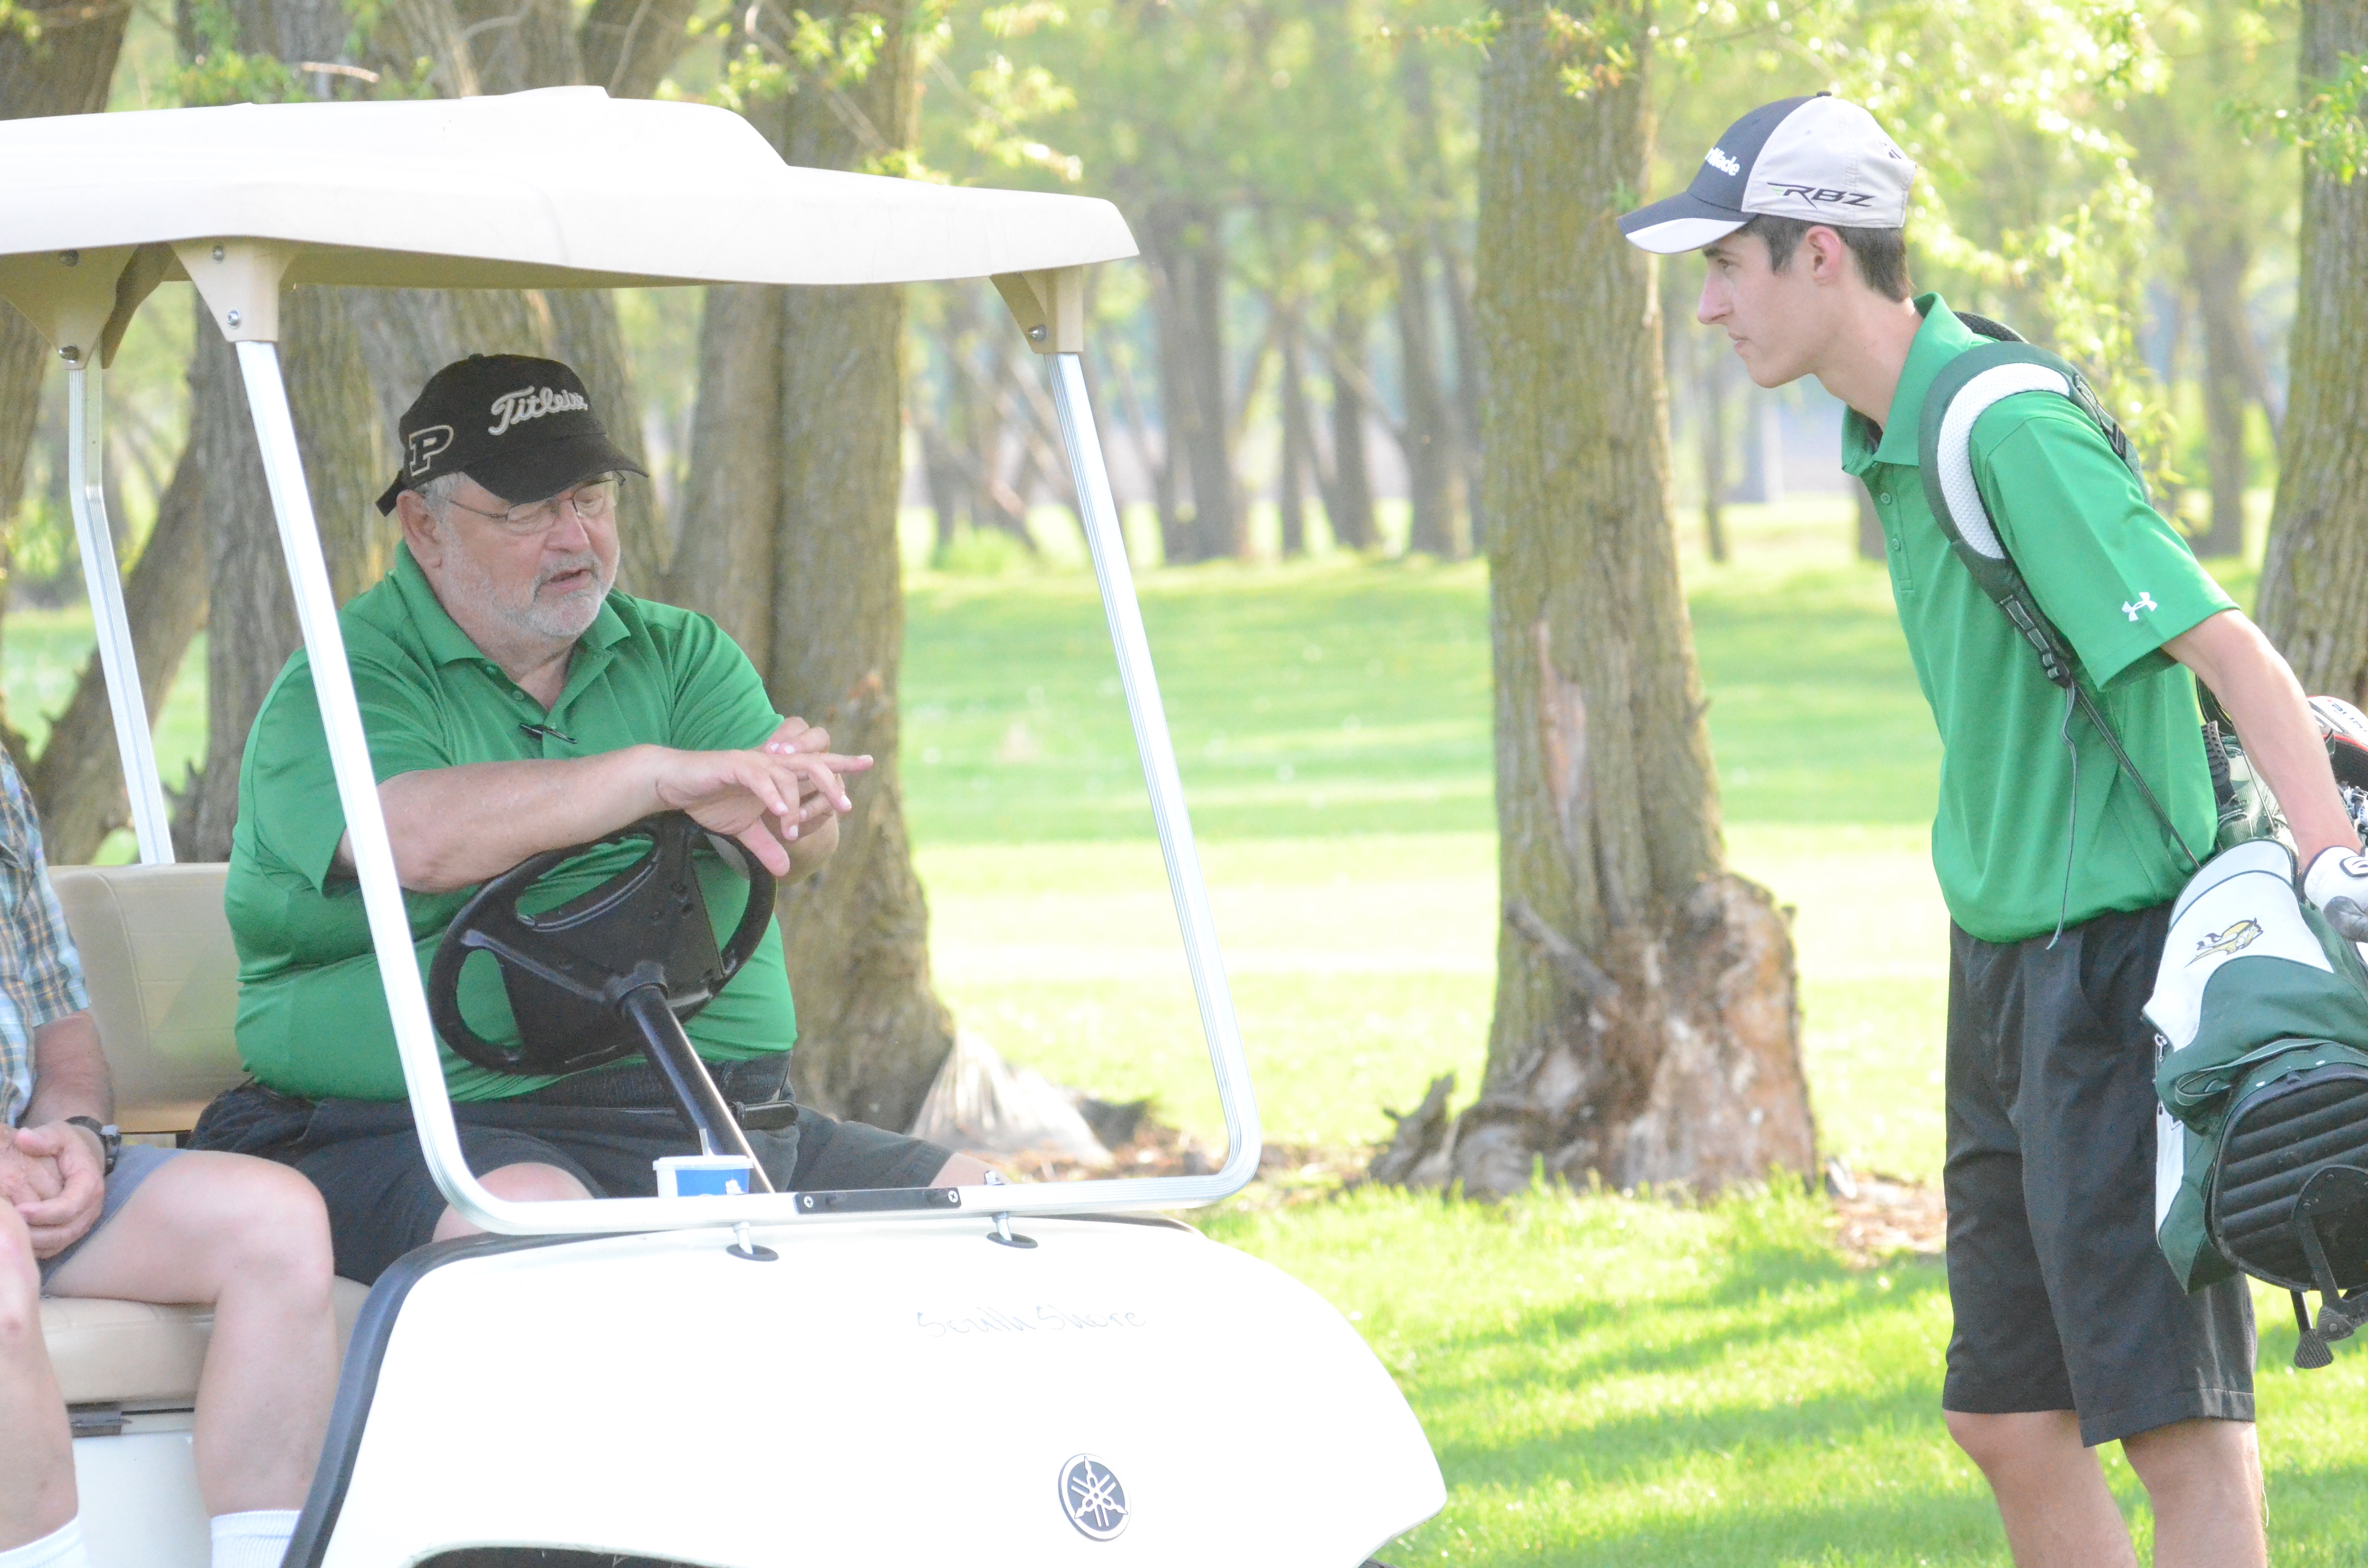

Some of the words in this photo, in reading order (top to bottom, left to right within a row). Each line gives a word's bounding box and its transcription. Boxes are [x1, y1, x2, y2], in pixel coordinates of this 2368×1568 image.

[1767, 182, 1875, 209] RBZ
[409, 425, 453, 477] P
[1036, 1304, 1146, 1330] Shore
